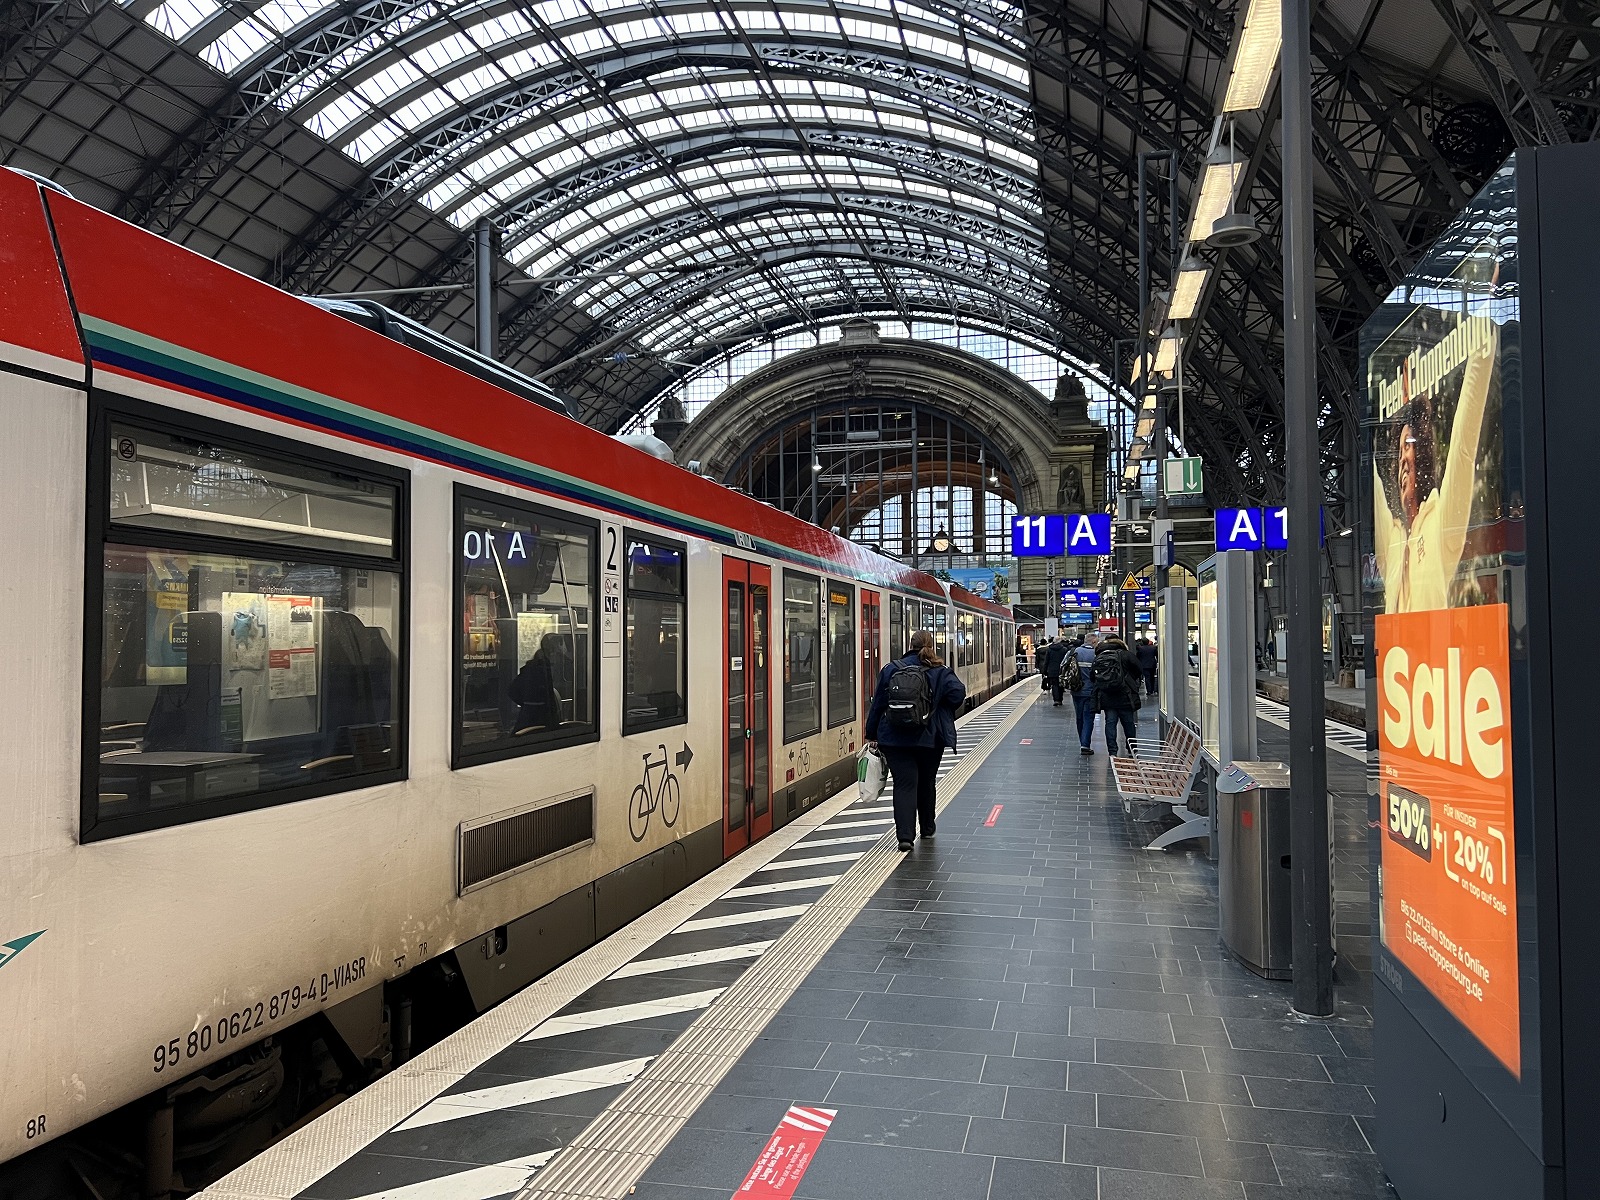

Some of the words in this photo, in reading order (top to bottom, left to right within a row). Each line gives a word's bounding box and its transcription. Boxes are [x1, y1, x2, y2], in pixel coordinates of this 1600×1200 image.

[1016, 515, 1046, 548] 11
[1070, 514, 1098, 547] A
[1229, 509, 1258, 542] A
[1274, 507, 1288, 540] 1
[606, 526, 617, 571] 2
[821, 578, 827, 603] 2
[1383, 646, 1504, 779] Sale
[1443, 803, 1454, 819] FÜR
[1454, 808, 1477, 829] INSIDER
[1389, 793, 1429, 850] 50%
[1453, 829, 1494, 885] 20%
[1461, 878, 1469, 891] on
[1469, 881, 1480, 900] top
[1481, 890, 1493, 906] auf
[1492, 896, 1507, 916] Sale
[418, 941, 428, 957] 7R
[1400, 898, 1410, 917] Bis
[1430, 922, 1439, 942] im
[1438, 930, 1457, 957] Store
[1457, 946, 1464, 963] &
[1464, 951, 1490, 984] Online
[153, 1037, 180, 1073] 95
[186, 1024, 212, 1059] 80
[217, 1001, 264, 1044] 0622
[269, 977, 317, 1020] 879-4
[320, 956, 366, 1002] D-VIASR
[26, 1114, 46, 1140] 8R
